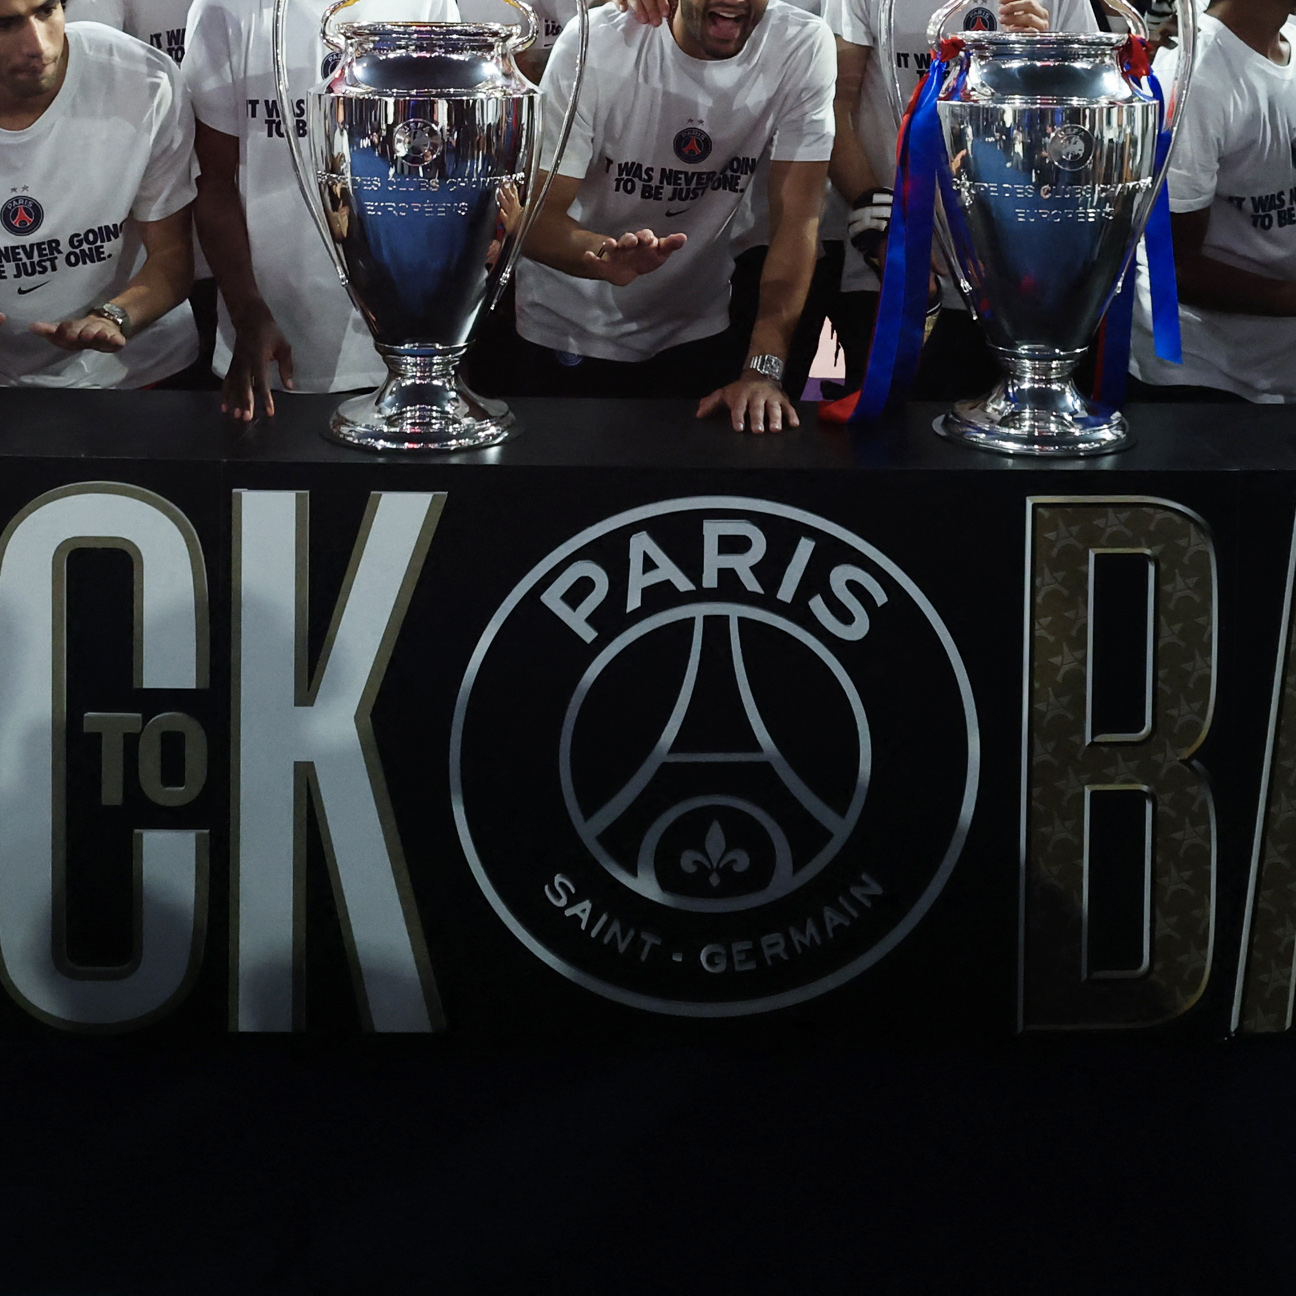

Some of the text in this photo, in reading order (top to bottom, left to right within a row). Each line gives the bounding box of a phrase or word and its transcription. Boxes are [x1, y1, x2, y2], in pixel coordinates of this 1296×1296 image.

[896, 52, 910, 68] IT
[264, 99, 306, 119] WS
[295, 119, 308, 138] B
[617, 161, 654, 184] WAS
[659, 167, 717, 187] NEVER
[614, 178, 636, 194] TO
[640, 183, 664, 201] BE
[6, 198, 34, 210] PARIS
[1250, 190, 1286, 214] WAS
[1251, 212, 1274, 231] TO
[1277, 207, 1296, 228] BE
[13, 256, 58, 279] JUST
[65, 245, 113, 268] ONE.
[540, 519, 889, 644] PARIS
[83, 711, 209, 808] TO
[544, 873, 662, 963] SAINT
[699, 872, 884, 974] GERMAIN
